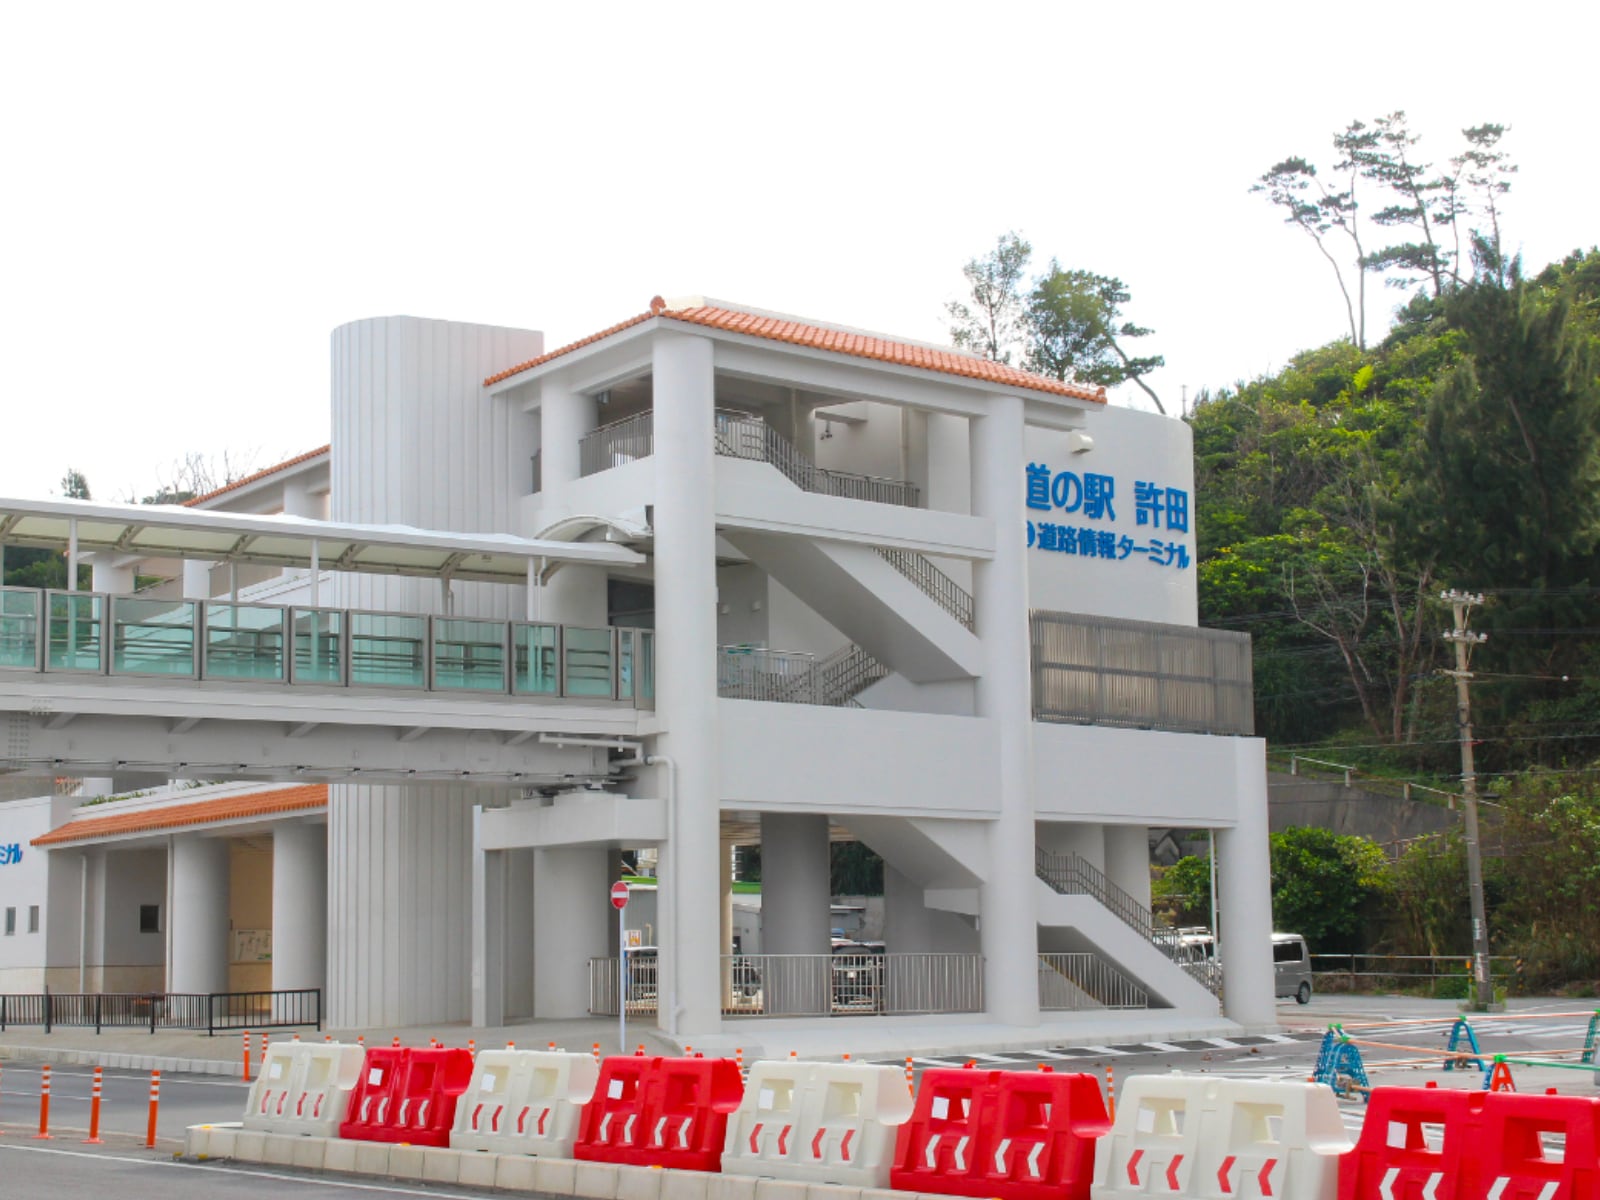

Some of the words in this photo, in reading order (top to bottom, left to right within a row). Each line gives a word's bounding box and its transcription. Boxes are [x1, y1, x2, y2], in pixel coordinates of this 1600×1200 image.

[1026, 462, 1116, 521] 道の駅
[1134, 481, 1188, 533] 許田
[1027, 520, 1190, 569] 道路情報ターミナル
